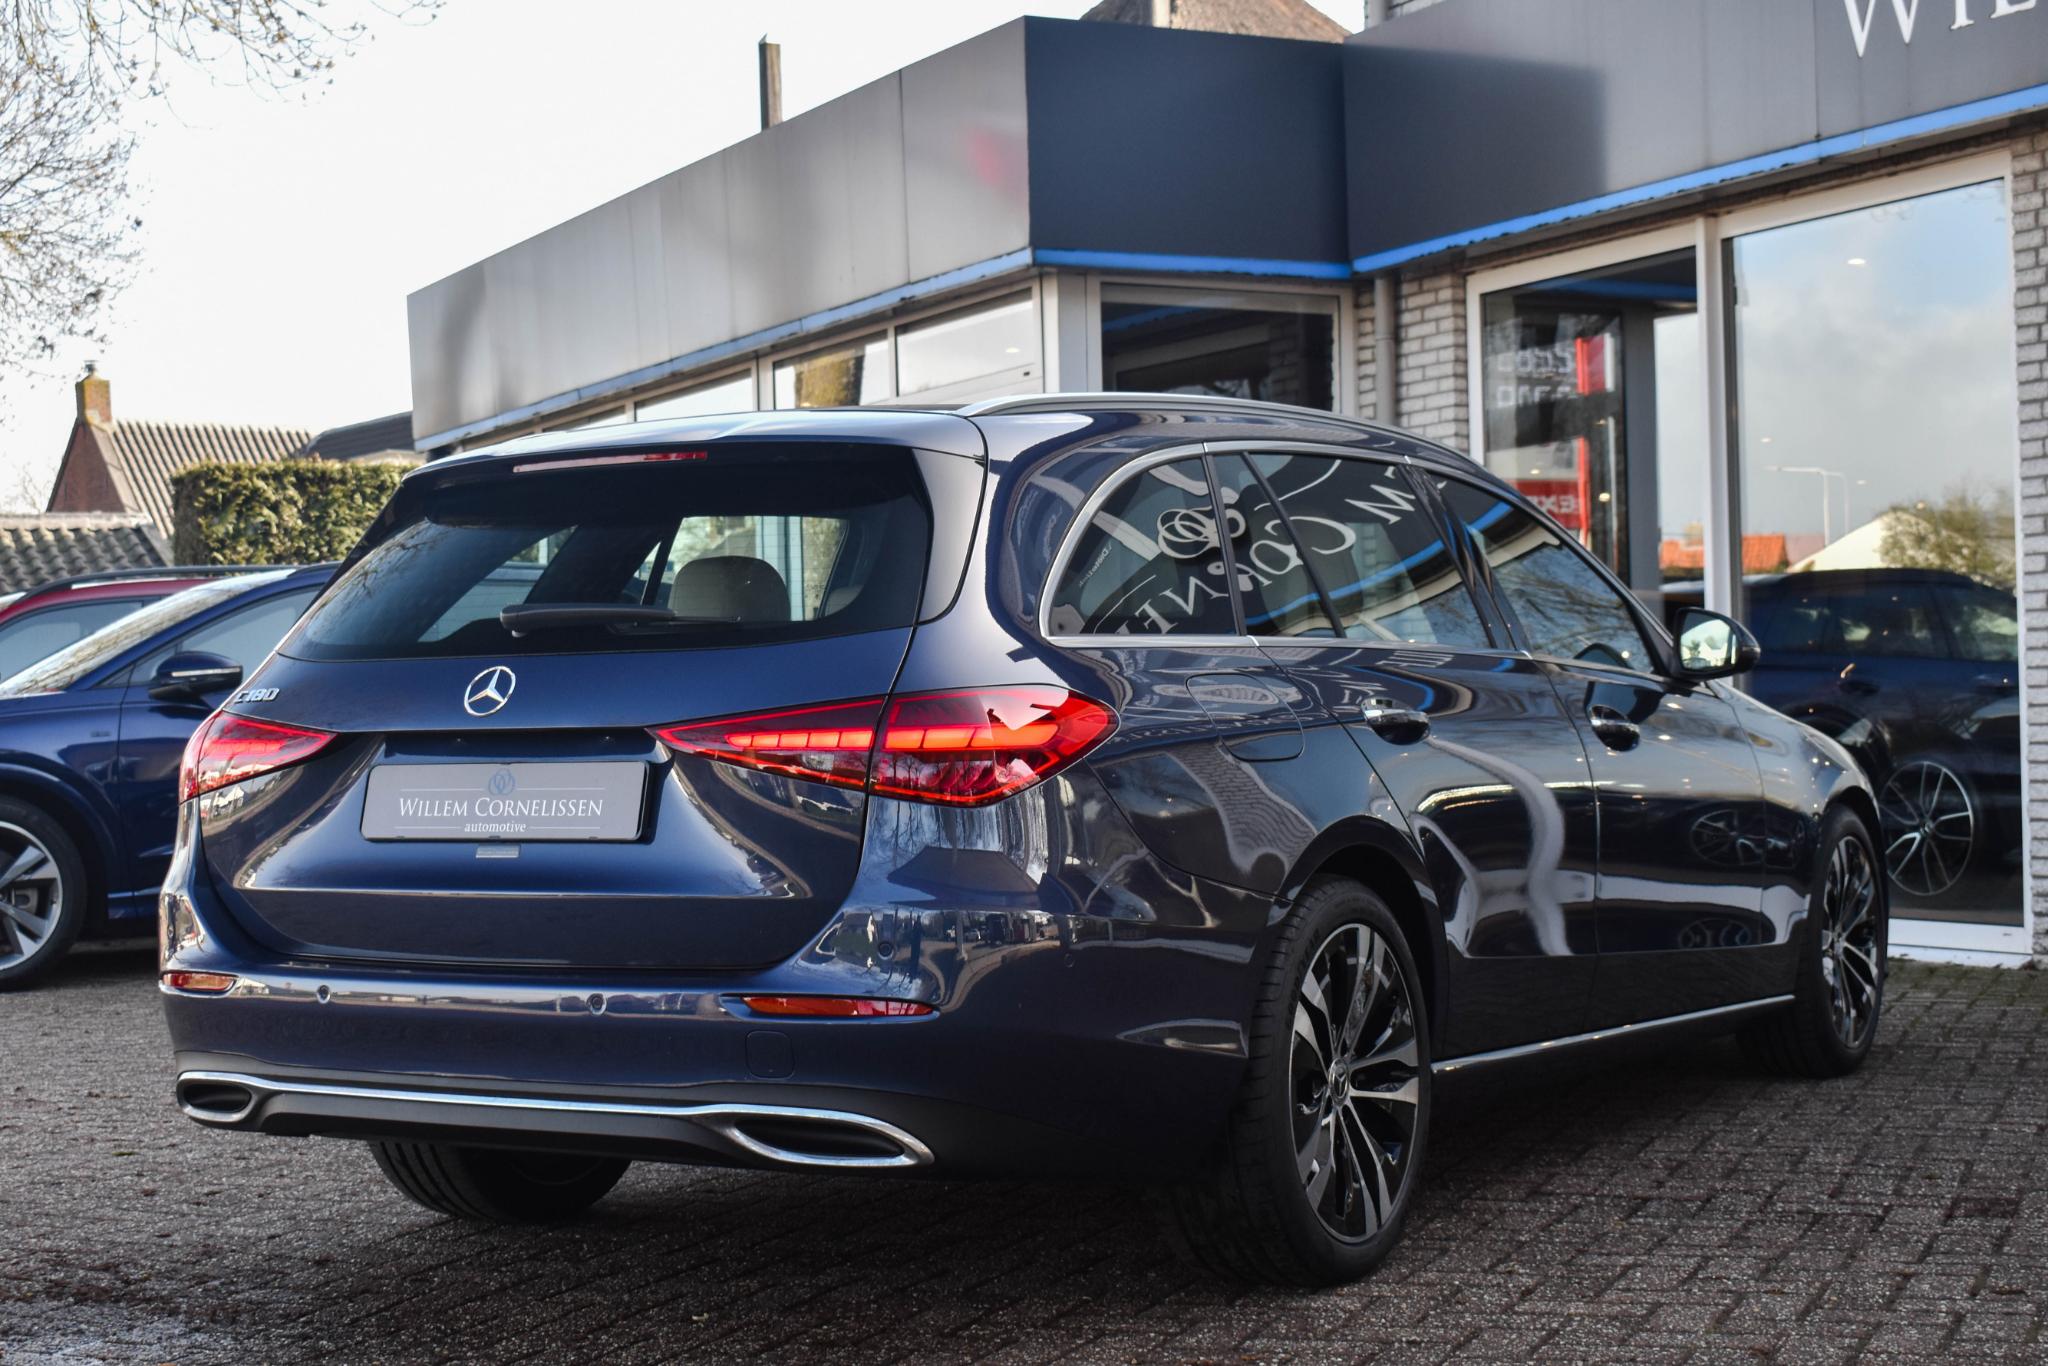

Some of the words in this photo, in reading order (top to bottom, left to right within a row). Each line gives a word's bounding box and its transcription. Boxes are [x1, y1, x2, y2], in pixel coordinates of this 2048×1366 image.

[234, 687, 280, 704] C180
[399, 797, 468, 817] WILLEM
[475, 797, 604, 817] CORNELISSEN
[464, 820, 527, 833] automotive
